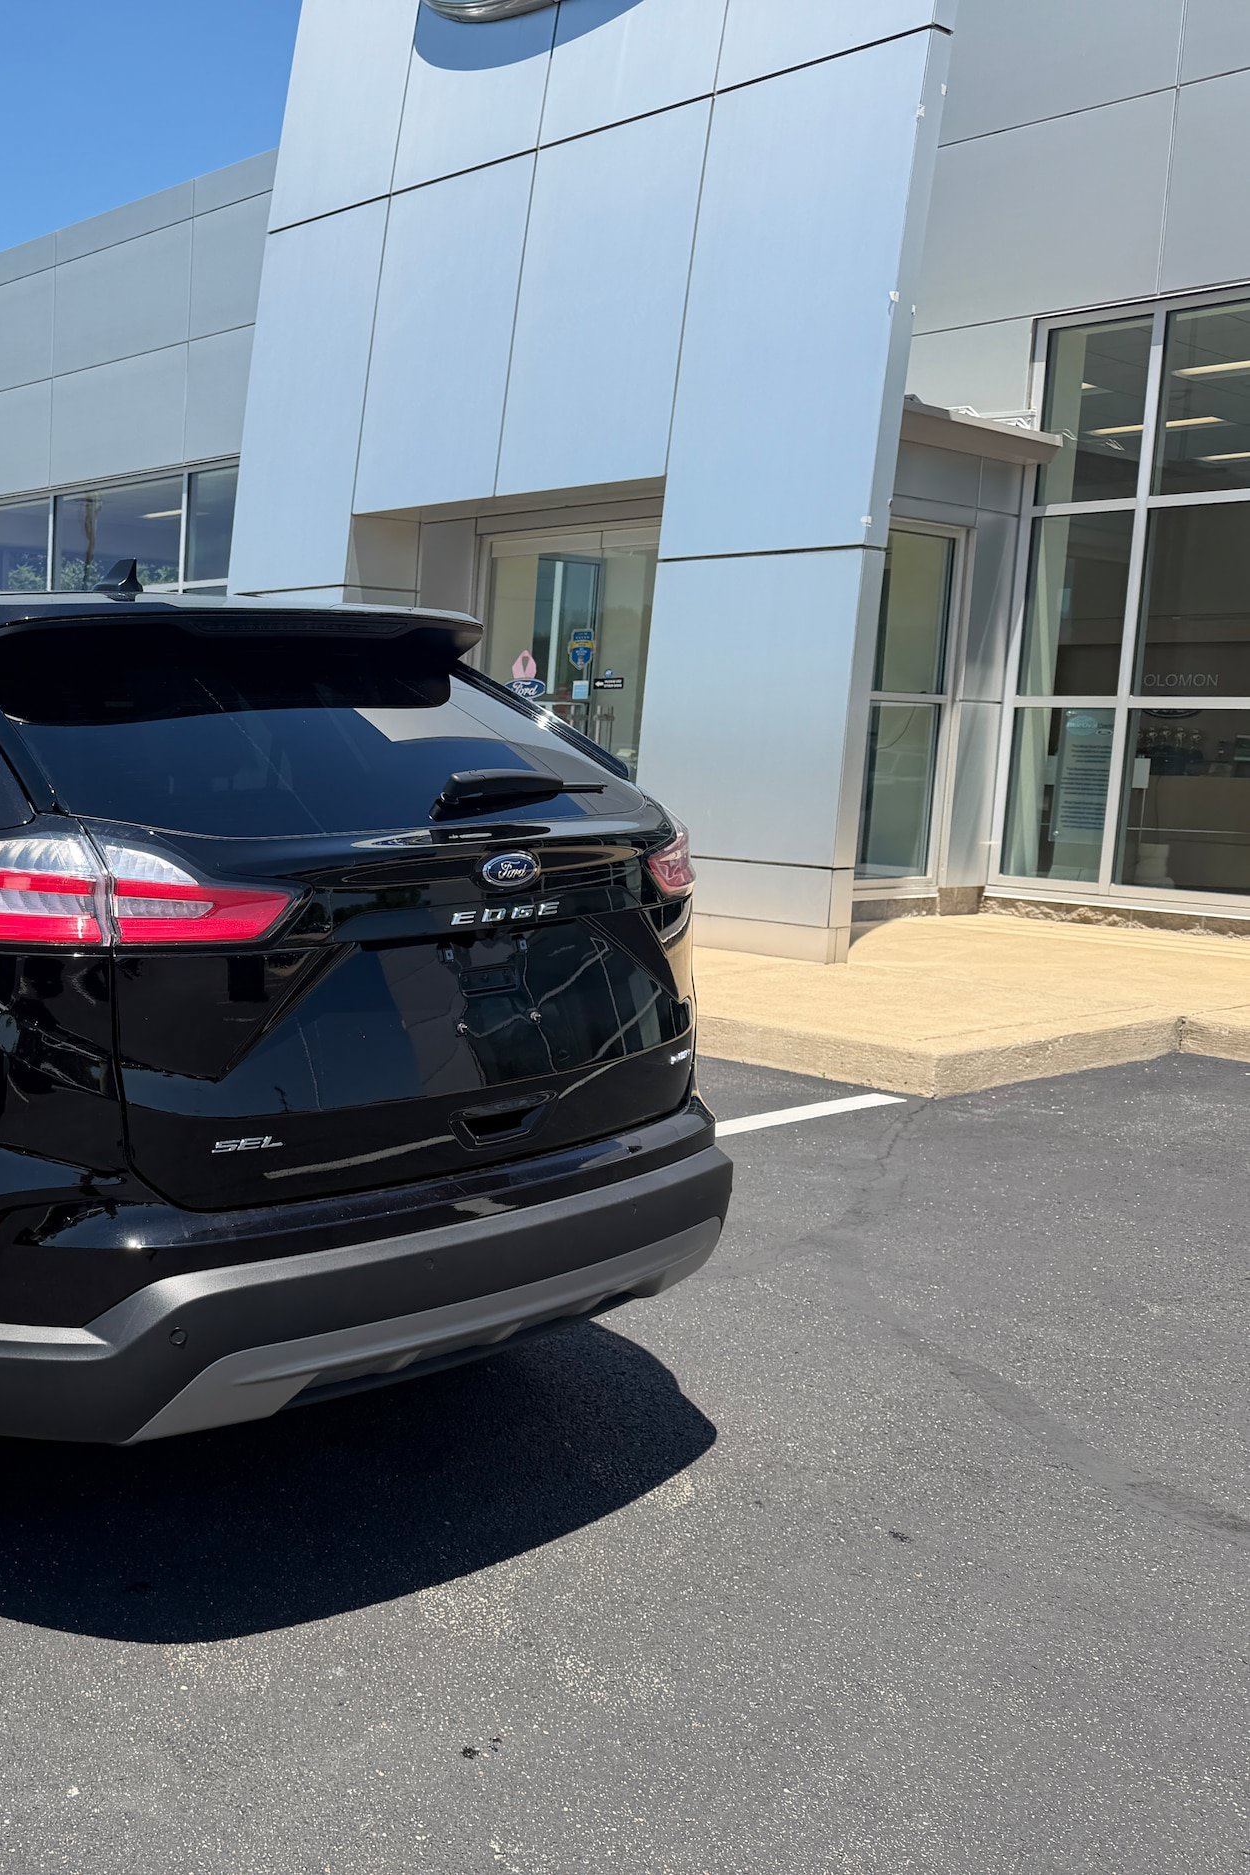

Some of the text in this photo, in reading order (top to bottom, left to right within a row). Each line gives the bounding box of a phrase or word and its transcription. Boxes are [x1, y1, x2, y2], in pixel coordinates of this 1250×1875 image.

[510, 681, 539, 696] Ford
[1143, 674, 1219, 691] OLOMON
[497, 860, 527, 880] Ford
[450, 901, 560, 926] EDGE
[211, 1135, 284, 1154] SEL
